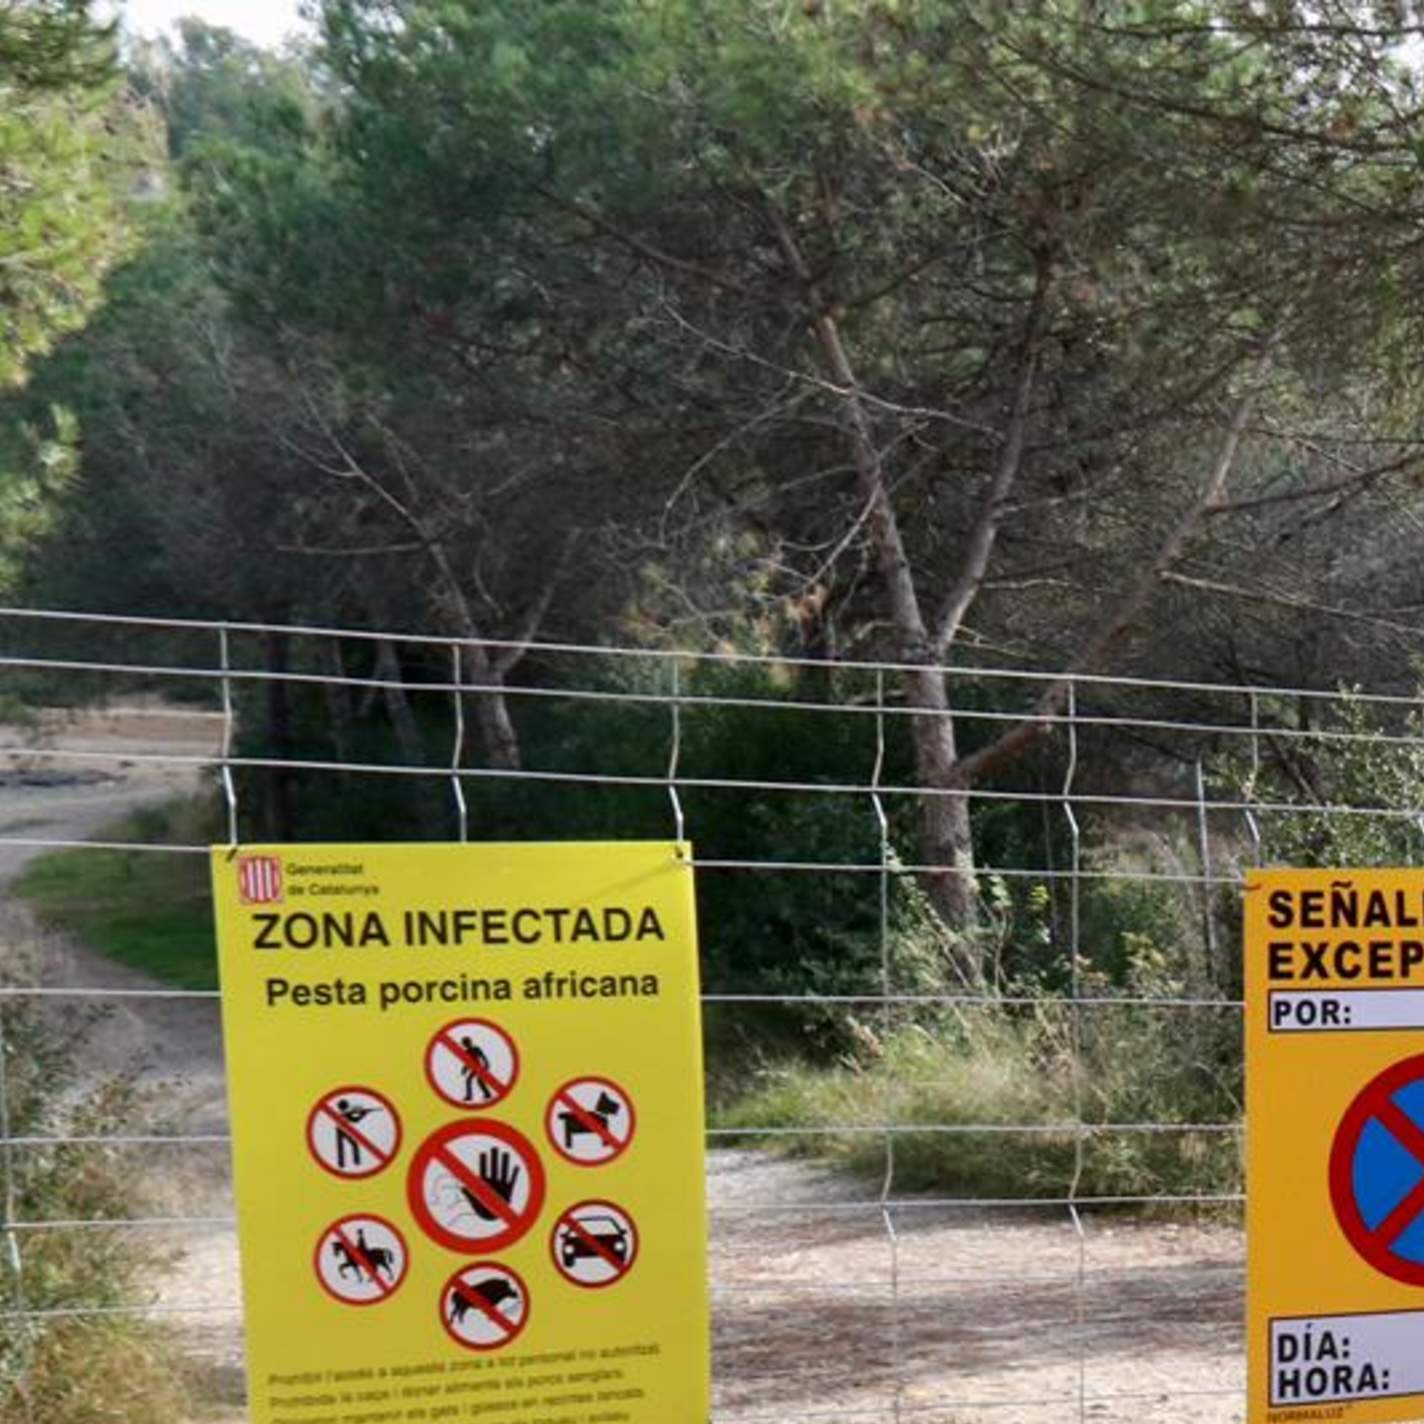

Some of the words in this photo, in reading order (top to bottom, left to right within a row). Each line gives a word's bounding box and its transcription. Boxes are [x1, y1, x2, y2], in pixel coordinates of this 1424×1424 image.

[286, 862, 364, 877] Generalitat
[287, 884, 304, 896] de
[253, 911, 390, 950] ZONA
[403, 906, 665, 946] INFECTADA
[266, 976, 367, 1008] Pesta
[380, 973, 513, 1012] porcina
[522, 969, 660, 1002] africana
[1273, 999, 1353, 1027] POR:
[1277, 1321, 1351, 1363] DÍA:
[1277, 1364, 1391, 1399] HORA:
